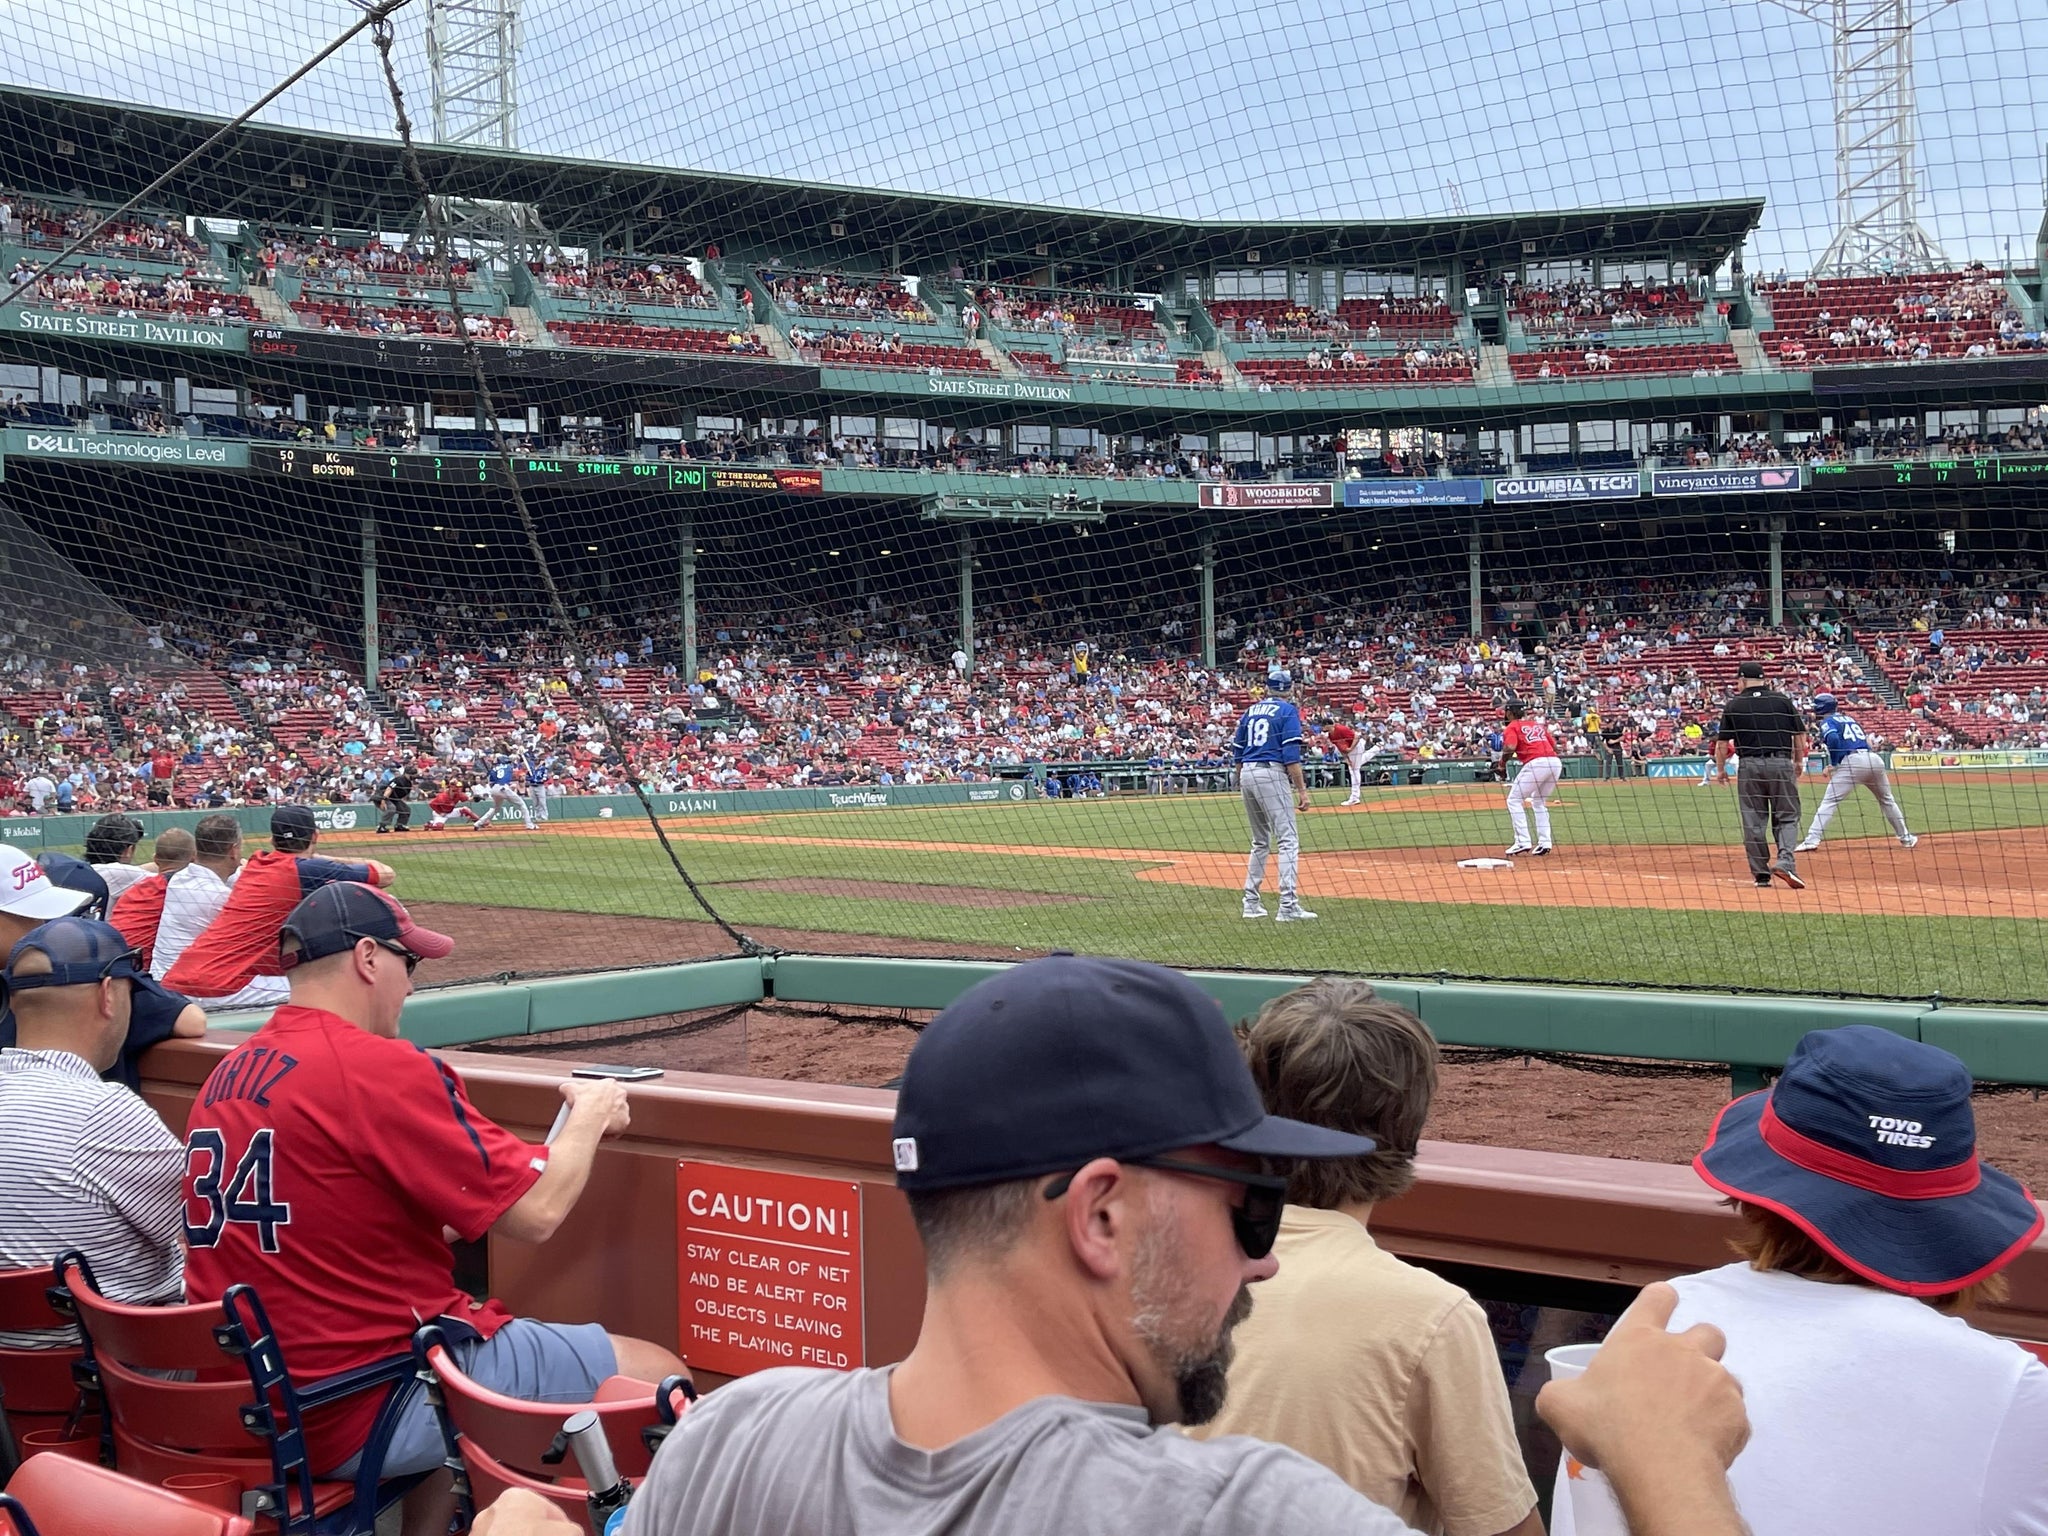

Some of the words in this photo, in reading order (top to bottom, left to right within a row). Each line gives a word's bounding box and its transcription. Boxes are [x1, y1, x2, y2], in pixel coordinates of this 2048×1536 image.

[20, 311, 72, 333] STATE
[76, 316, 139, 338] STREET
[144, 322, 224, 346] PAVILION
[253, 330, 265, 338] AT
[266, 330, 282, 339] BAT
[378, 341, 386, 349] G
[929, 378, 965, 393] STATE
[967, 380, 1011, 397] STREET
[1014, 383, 1071, 399] PAVILION
[27, 435, 78, 453] DELL
[78, 438, 182, 461] Technologies
[187, 446, 225, 461] Level
[280, 450, 294, 460] 50
[325, 453, 340, 463] KC
[390, 456, 397, 466] 0
[435, 458, 441, 467] 3
[479, 459, 486, 469] 0
[282, 462, 292, 472] 17
[312, 464, 355, 476] BOSTON
[529, 461, 562, 472] BALL
[578, 463, 621, 475] STRIKE
[633, 465, 657, 476] OUT
[1930, 461, 1957, 470] STRIKES
[479, 471, 486, 481] 0
[674, 470, 701, 484] 2ND
[1897, 472, 1911, 483] 24
[1937, 471, 1948, 481] 17
[1977, 469, 1987, 479] 71
[1497, 478, 1586, 495] COLUMBIA
[1659, 475, 1717, 490] vineyard
[1720, 474, 1756, 486] vines
[1245, 487, 1321, 498] WOODBRIDGE
[1422, 495, 1445, 504] Medical
[1446, 495, 1466, 503] Center
[1247, 718, 1269, 747] 18
[1521, 725, 1548, 744] 22
[829, 792, 887, 805] TouchView
[669, 798, 716, 814] DASANI
[13, 826, 41, 836] Mobile
[204, 1048, 299, 1108] ORTIZ
[1868, 1115, 1922, 1134] TOYO
[1876, 1130, 1934, 1149] TIRES
[180, 1127, 291, 1254] 34
[687, 1188, 849, 1239] CAUTION!
[687, 1243, 721, 1261] STAY
[728, 1250, 780, 1272] CLEAR
[788, 1260, 811, 1276] OF
[818, 1265, 850, 1283] NET
[689, 1271, 720, 1288] AND
[727, 1277, 748, 1293] BE
[754, 1283, 805, 1304] ALERT
[813, 1292, 847, 1312] FOR
[695, 1298, 767, 1325] OBJECTS
[774, 1312, 842, 1339] LEAVING
[690, 1323, 721, 1343] THE
[728, 1331, 793, 1358] PLAYING
[801, 1345, 848, 1368] FIELD
